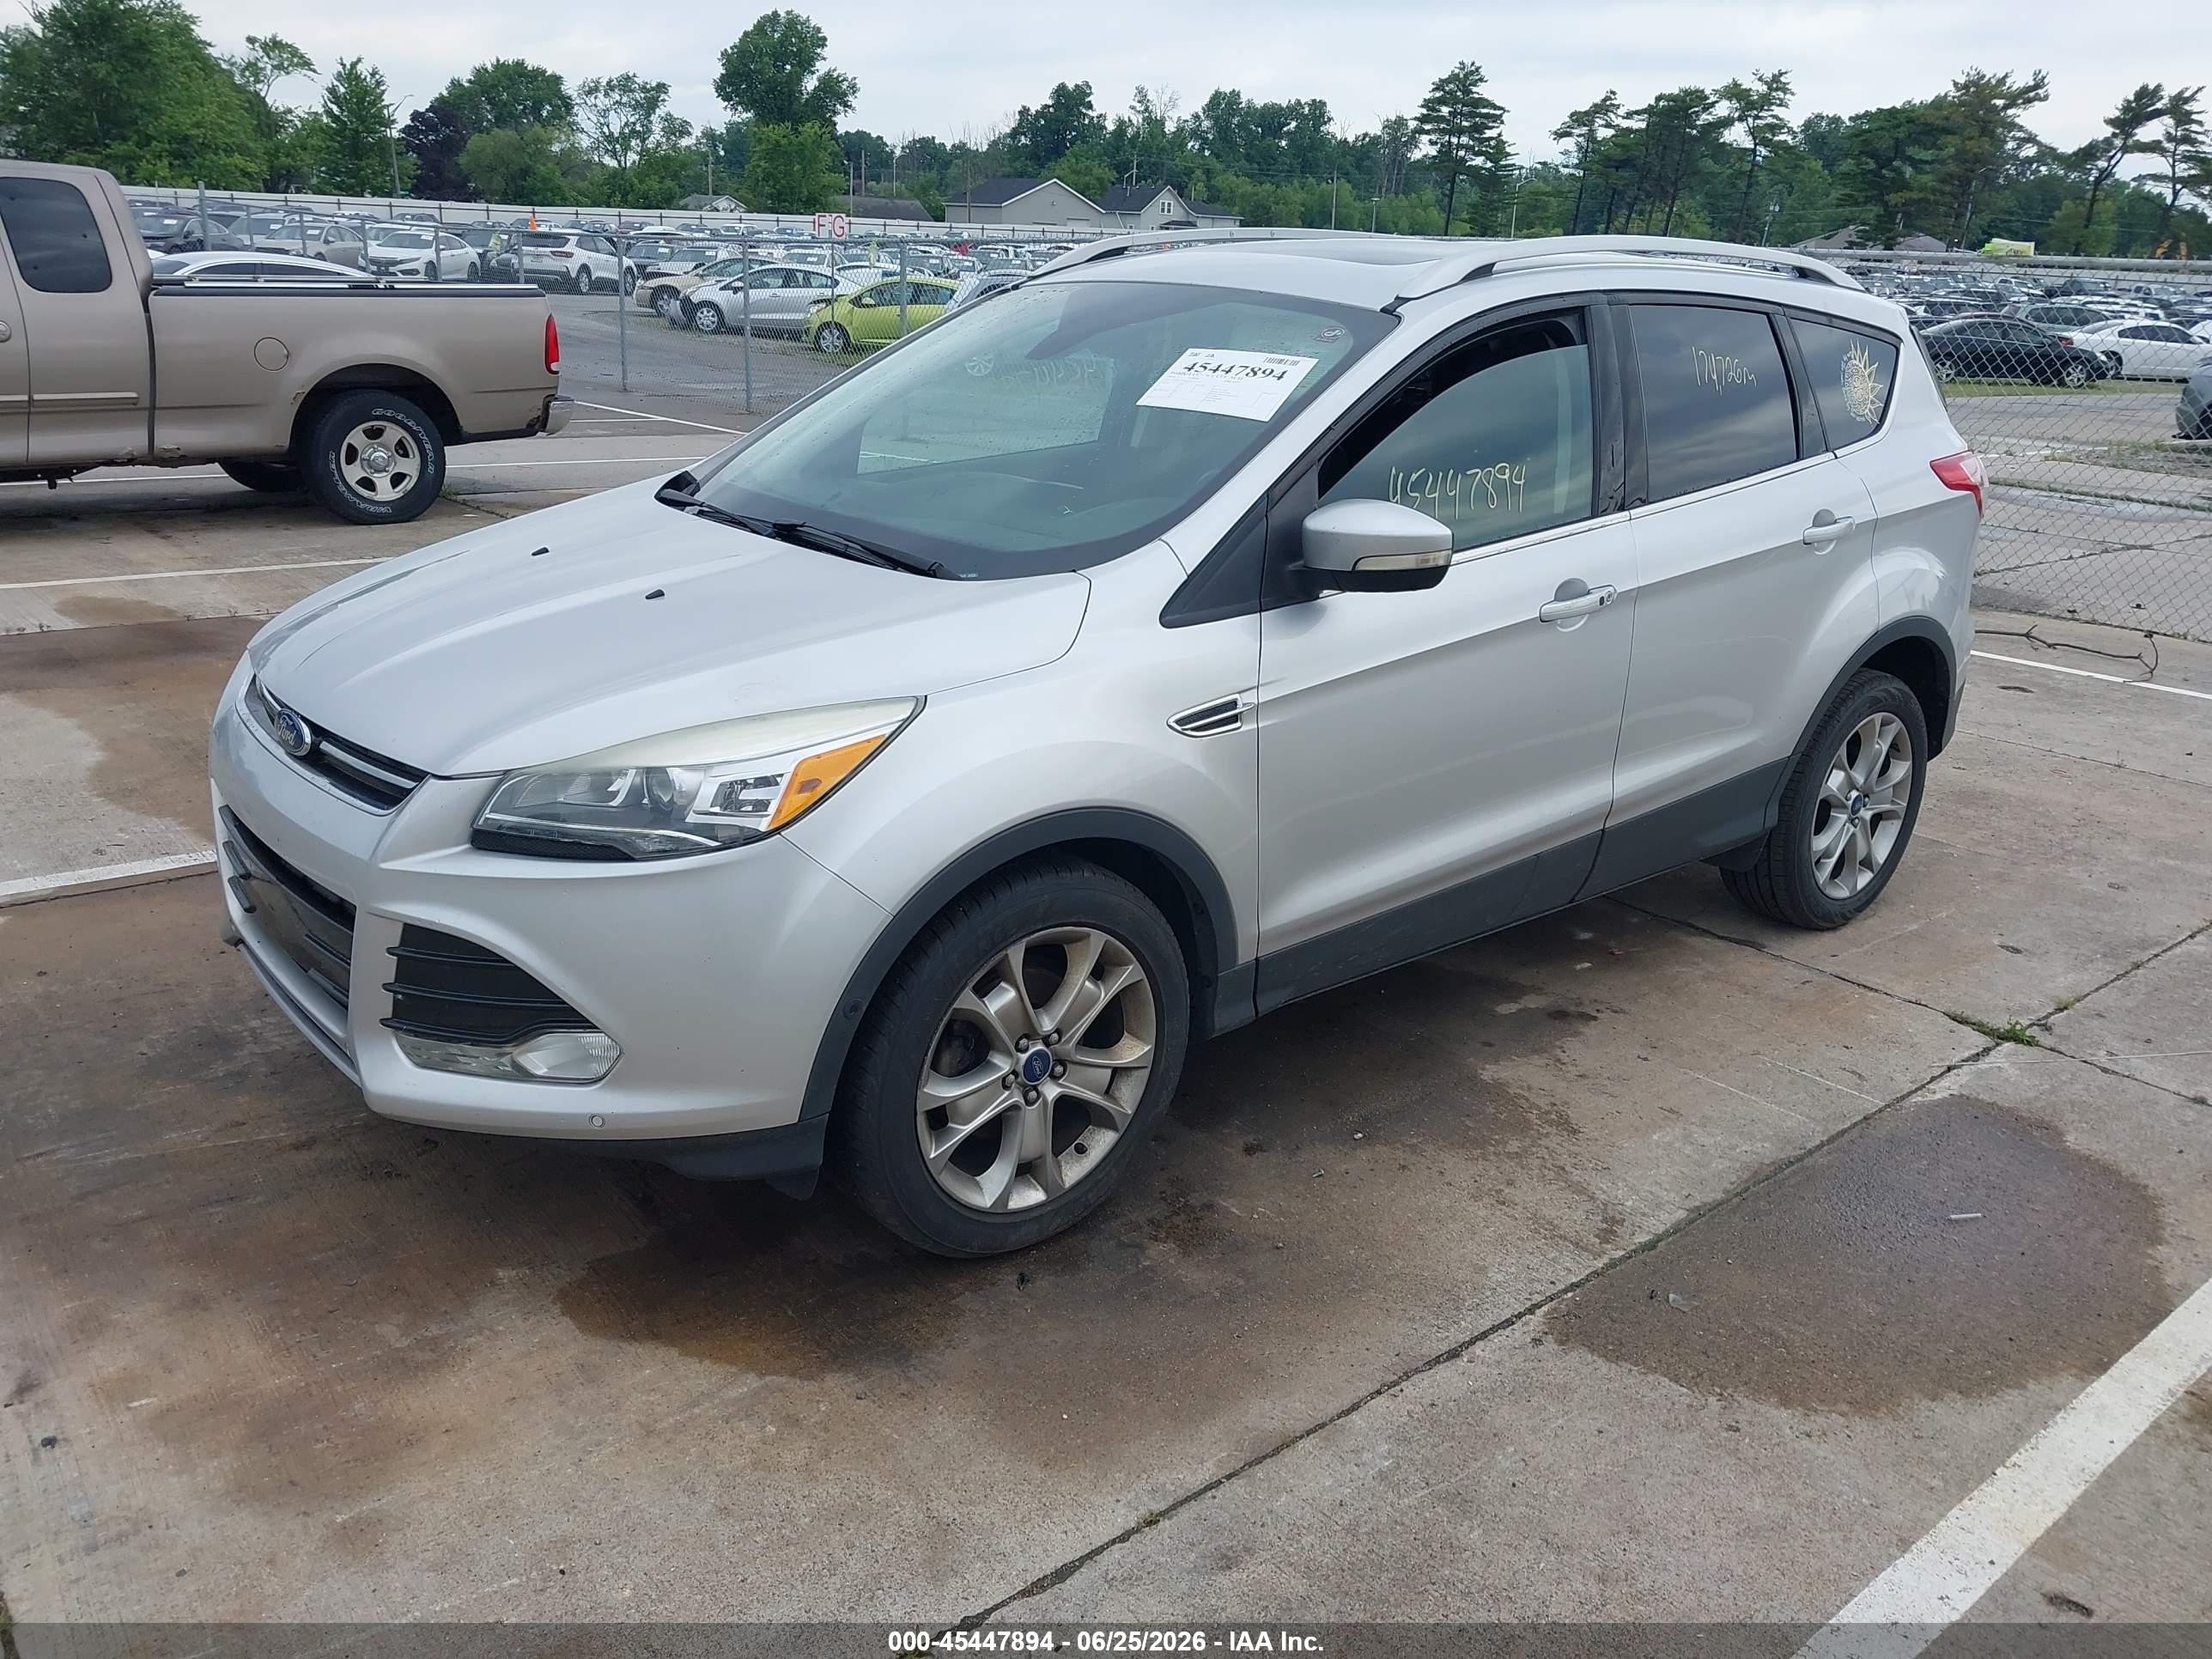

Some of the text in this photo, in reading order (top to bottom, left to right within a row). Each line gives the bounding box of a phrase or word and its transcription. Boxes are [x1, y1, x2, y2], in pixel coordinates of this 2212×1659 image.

[1182, 361, 1289, 382] 45447894
[371, 408, 434, 475] GOODYEAR
[1389, 462, 1526, 520] 45447894
